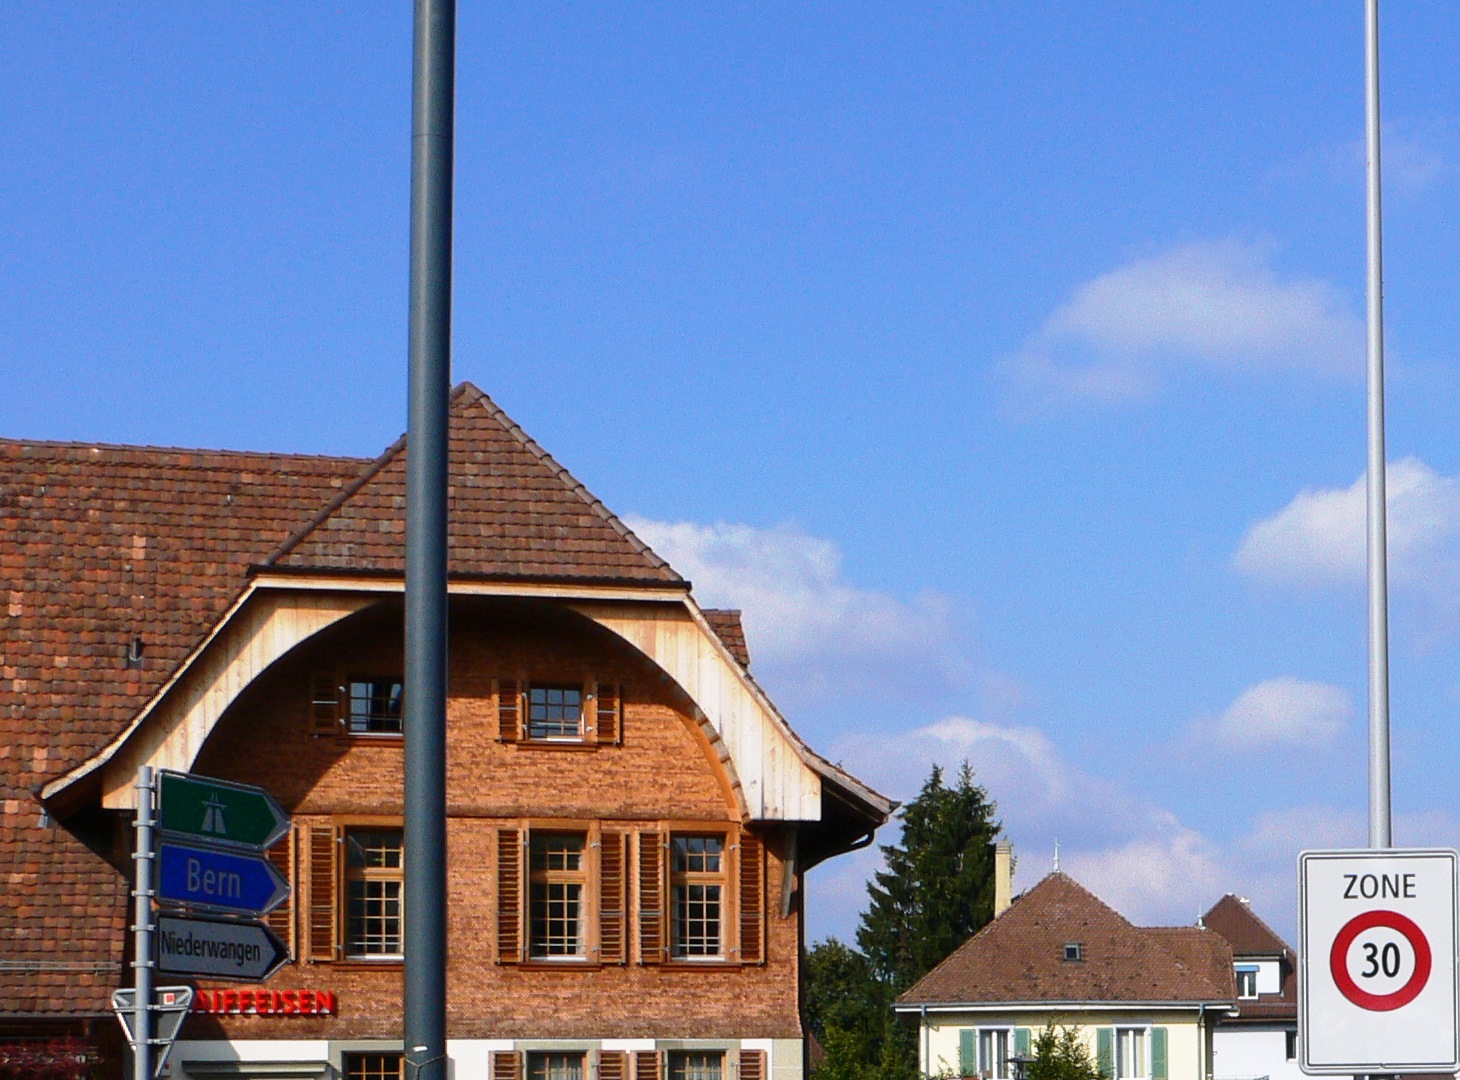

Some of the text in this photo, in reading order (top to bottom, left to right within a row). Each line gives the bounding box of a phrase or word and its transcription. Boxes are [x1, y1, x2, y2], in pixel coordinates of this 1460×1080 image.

[187, 858, 241, 898] Bern
[1343, 873, 1417, 899] ZONE
[160, 930, 262, 966] Niederwangen
[1361, 942, 1401, 978] 30
